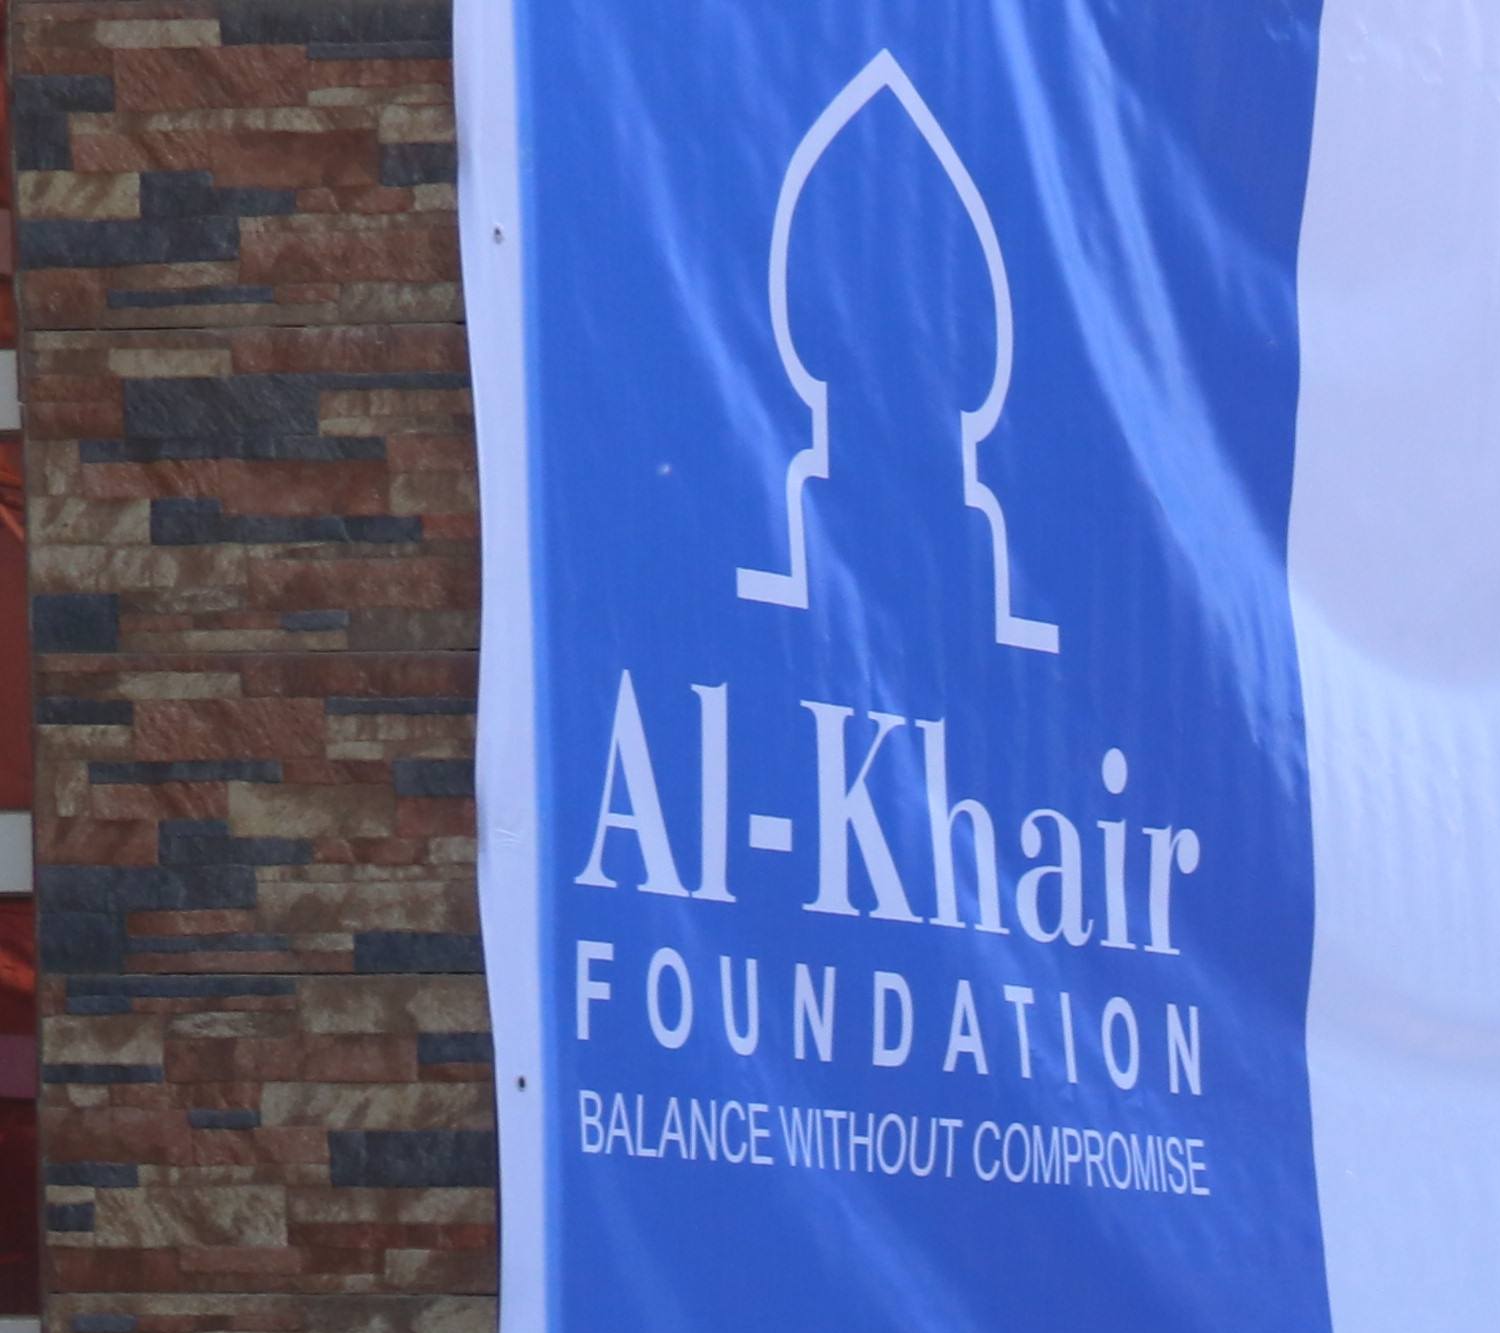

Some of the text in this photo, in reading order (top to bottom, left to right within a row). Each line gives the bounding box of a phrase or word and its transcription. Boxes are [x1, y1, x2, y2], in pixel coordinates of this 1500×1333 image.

[573, 668, 1199, 955] Al-Khair
[574, 941, 1203, 1097] FOUNDATION
[579, 1090, 1211, 1196] BALANCE WITHOUT COMPROMISE
